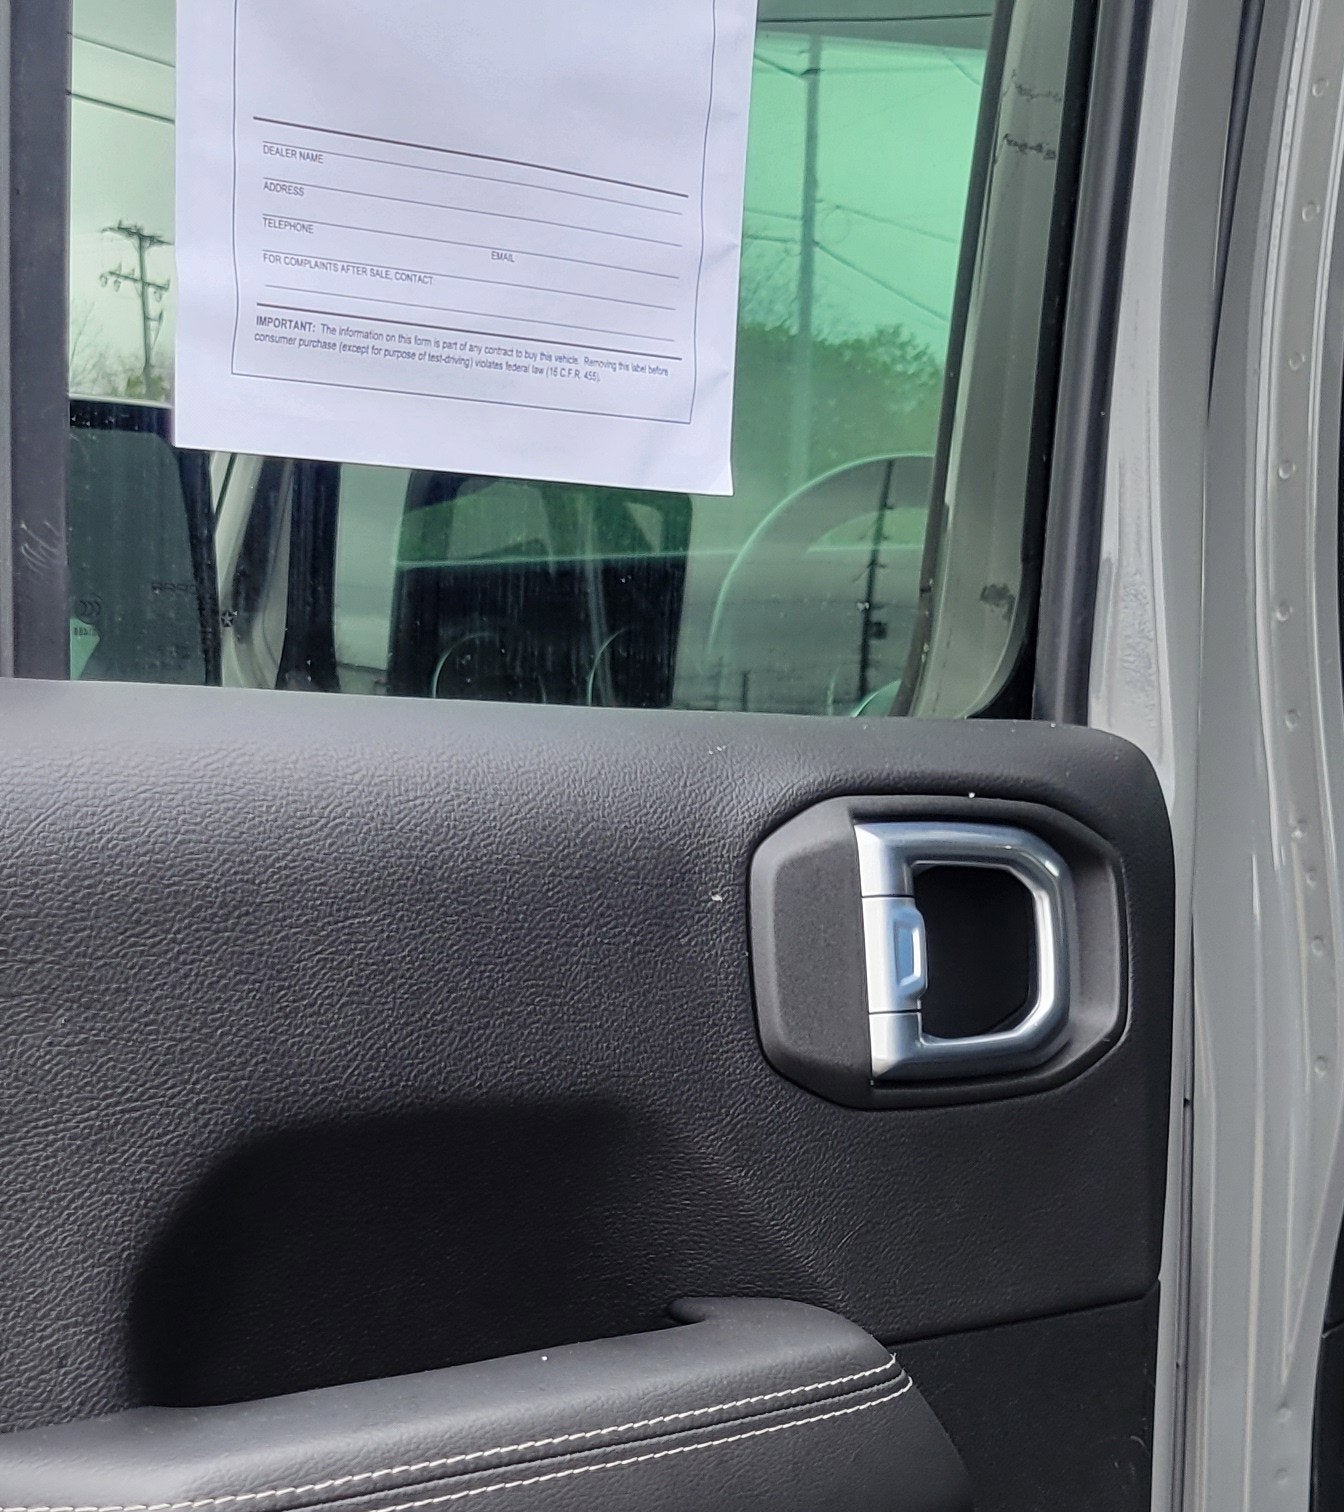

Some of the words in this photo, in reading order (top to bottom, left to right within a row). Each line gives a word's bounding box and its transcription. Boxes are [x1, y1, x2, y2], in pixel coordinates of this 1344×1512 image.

[263, 144, 297, 159] DEALER
[299, 151, 324, 164] NAME
[263, 181, 305, 197] ADDRESS
[262, 217, 314, 234] TELEPHONE
[491, 250, 515, 263] EMAIL
[263, 253, 282, 265] FOR
[283, 256, 339, 272] COMPLAINTS
[340, 264, 368, 276] AFTER
[394, 271, 434, 285] CONTACT
[254, 332, 297, 346] consumer
[298, 338, 337, 351] purchase
[371, 345, 383, 355] for
[384, 348, 416, 361] purpose
[418, 350, 427, 360] of
[474, 358, 503, 370] violates
[505, 361, 530, 373] federal
[531, 364, 544, 375] law
[256, 315, 316, 333] IMPORTANT:
[321, 322, 337, 335] The
[338, 326, 384, 341] information
[385, 333, 396, 343] on
[398, 334, 412, 345] this
[414, 335, 432, 346] form
[434, 339, 441, 348] is
[442, 340, 458, 351] part
[459, 342, 468, 351] of
[469, 343, 483, 355] any
[484, 346, 514, 357] contract
[515, 349, 523, 358] to
[524, 349, 538, 362] buy
[540, 352, 553, 362] this
[584, 356, 617, 372] Removing
